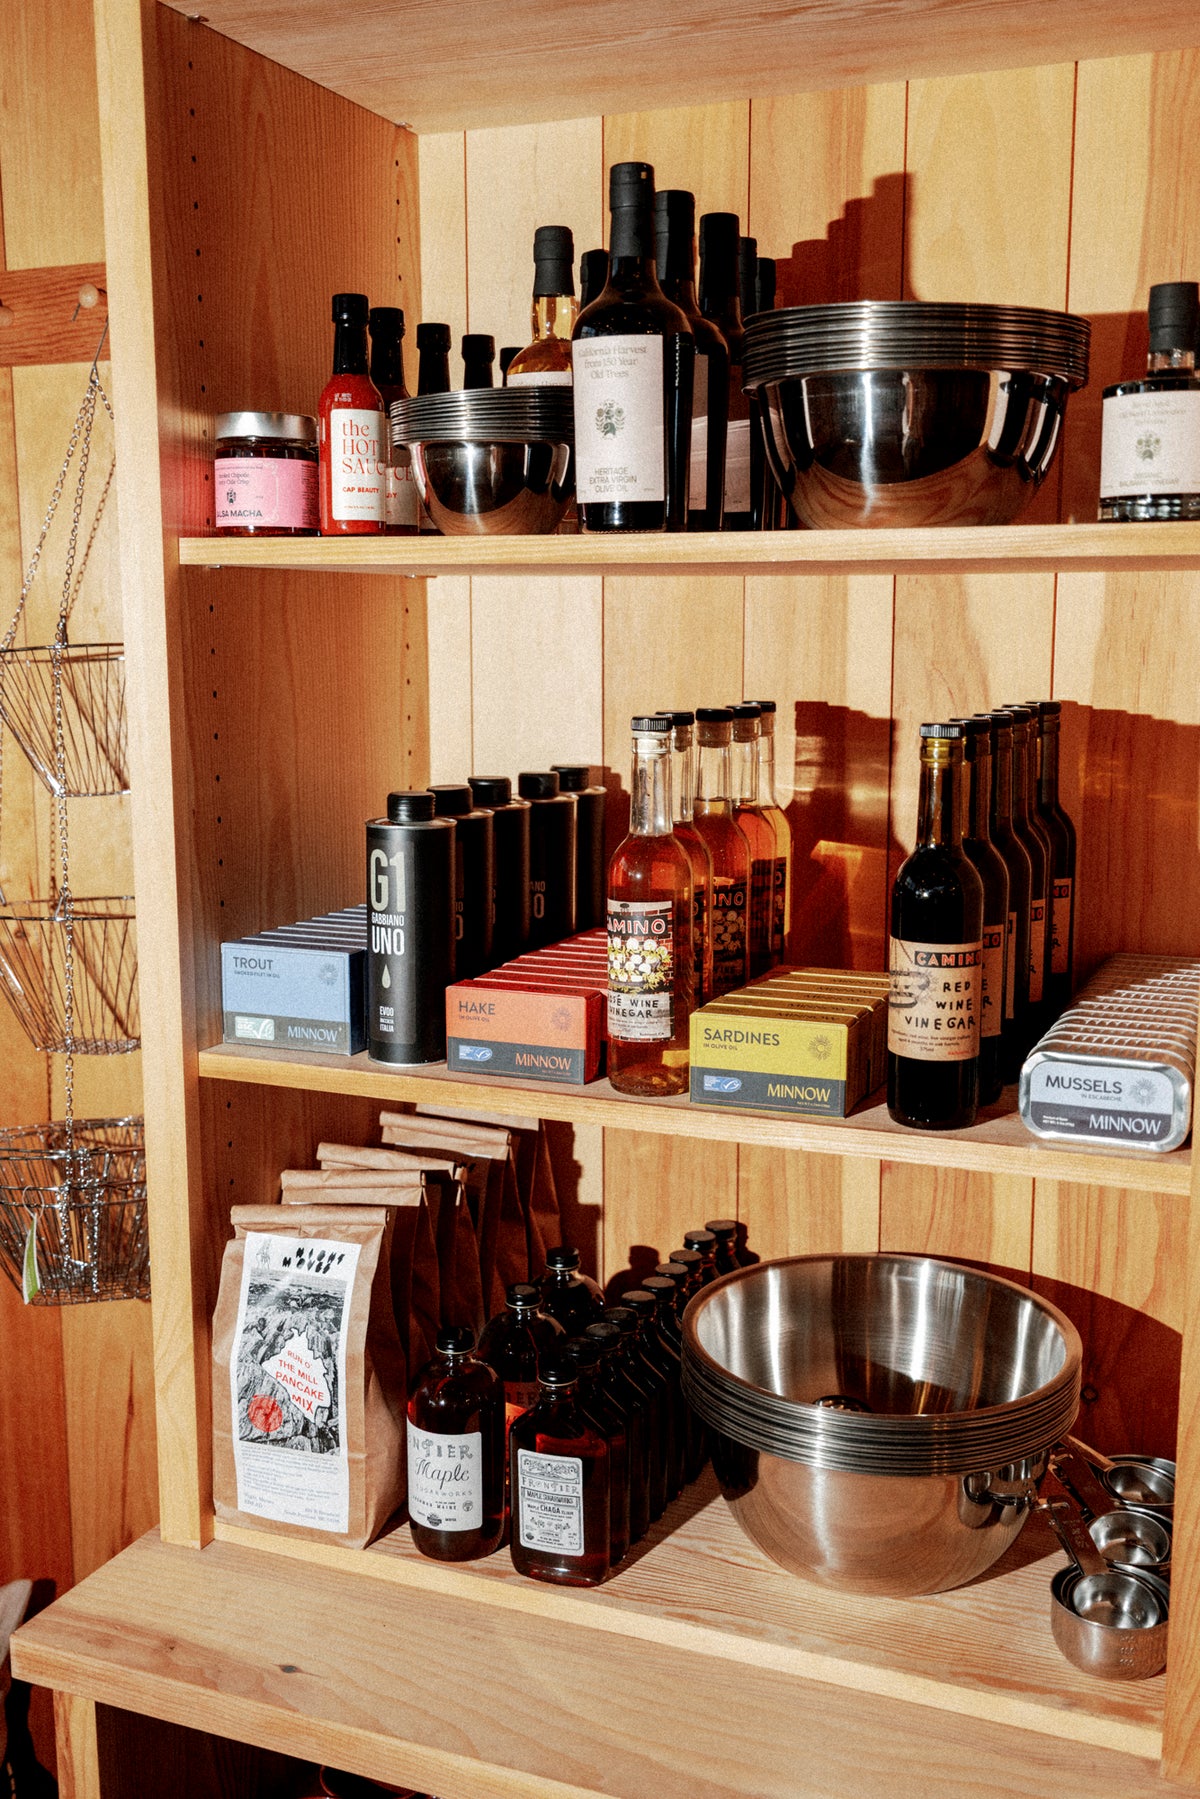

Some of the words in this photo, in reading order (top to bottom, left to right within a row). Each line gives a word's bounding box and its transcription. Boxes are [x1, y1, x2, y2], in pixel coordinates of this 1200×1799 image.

[342, 420, 369, 436] the
[343, 439, 380, 456] HOT
[342, 458, 386, 476] SAUC
[370, 848, 406, 913] G1
[372, 912, 404, 926] GABBIANO
[607, 918, 666, 934] AMINO
[372, 928, 405, 956] UNO
[233, 956, 274, 970] TROUT
[943, 982, 972, 993] RED
[459, 1000, 496, 1015] HAKE
[609, 1006, 652, 1018] VINEGAR
[630, 999, 659, 1008] WINE
[936, 1000, 974, 1011] WINE
[904, 1016, 976, 1030] VINEGAR
[288, 1025, 338, 1042] MINNOW
[704, 1028, 780, 1046] SARDINES
[516, 1052, 572, 1070] MINNOW
[767, 1083, 831, 1102] MINNOW
[1046, 1074, 1122, 1094] MUSSELS
[1089, 1114, 1161, 1135] MINNOW
[282, 1256, 331, 1274] MOVES
[287, 1350, 303, 1364] RUN
[278, 1359, 296, 1372] THE
[298, 1370, 318, 1385] MILL
[275, 1371, 324, 1400] PANCAKE
[292, 1394, 314, 1415] MIX
[412, 1438, 473, 1460] NTIER
[416, 1458, 470, 1490] Maple
[522, 1477, 579, 1495] FRONTIER
[540, 1503, 560, 1513] CHAGA
